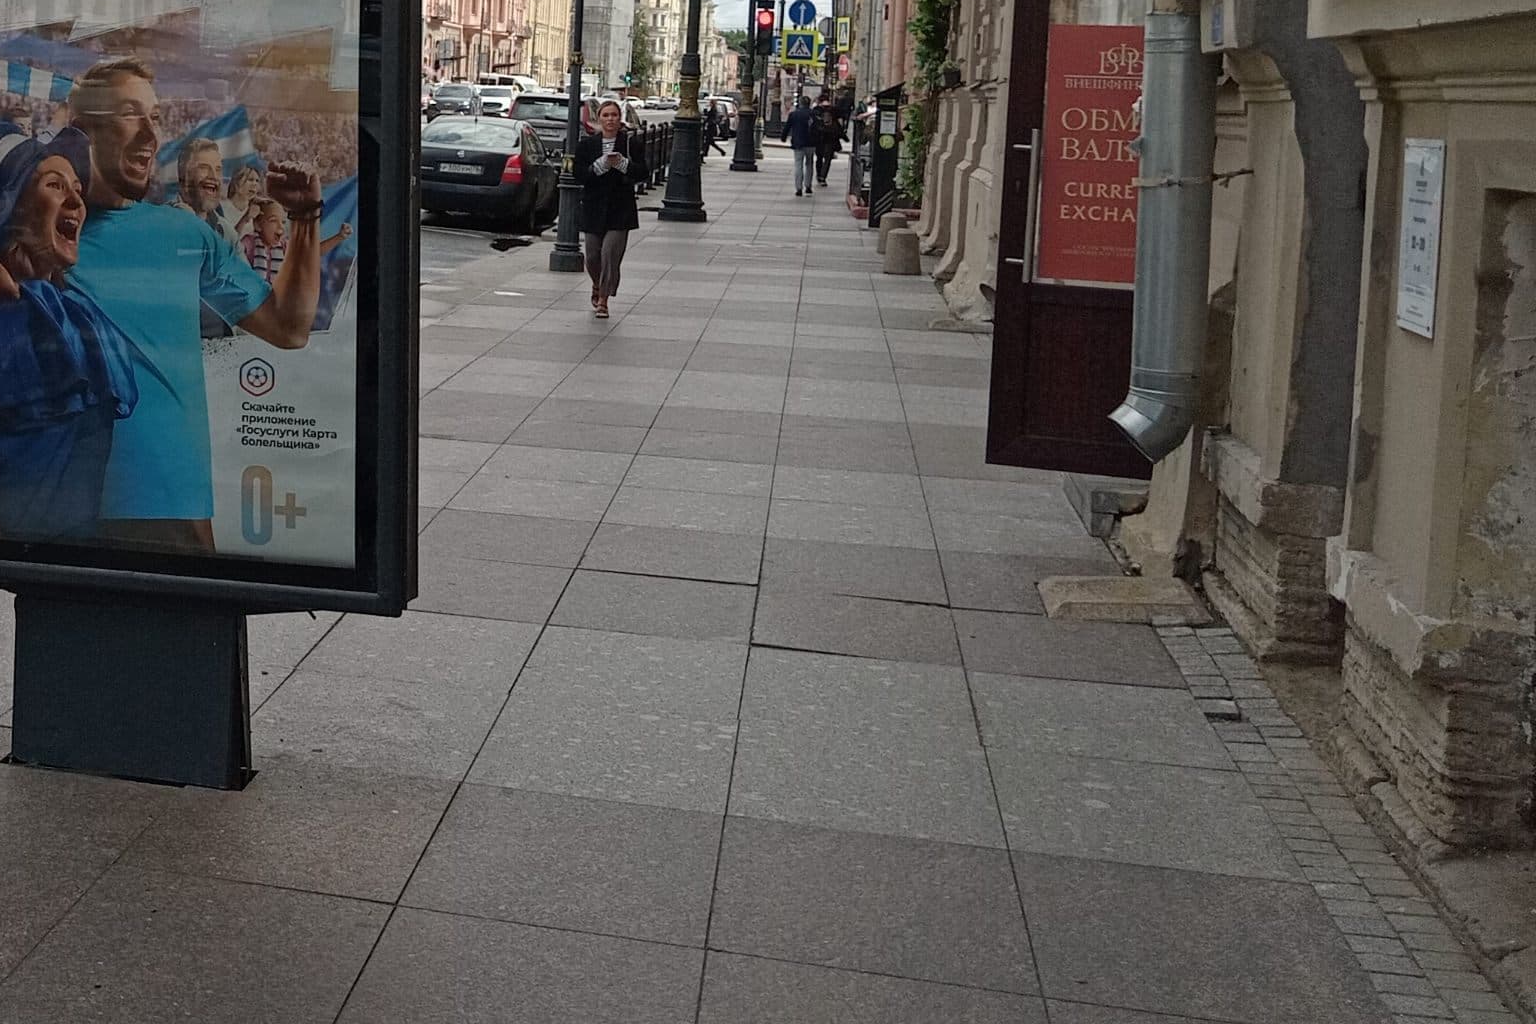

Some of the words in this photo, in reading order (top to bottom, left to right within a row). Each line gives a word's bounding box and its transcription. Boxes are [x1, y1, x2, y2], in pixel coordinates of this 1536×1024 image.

[1060, 204, 1136, 223] EXCHA
[241, 401, 295, 414] Скачайте
[241, 414, 316, 428] приложение
[236, 425, 299, 441] «Госуслуги
[302, 429, 338, 443] Карта
[241, 435, 320, 450] болельщика»
[241, 464, 307, 545] 0+
